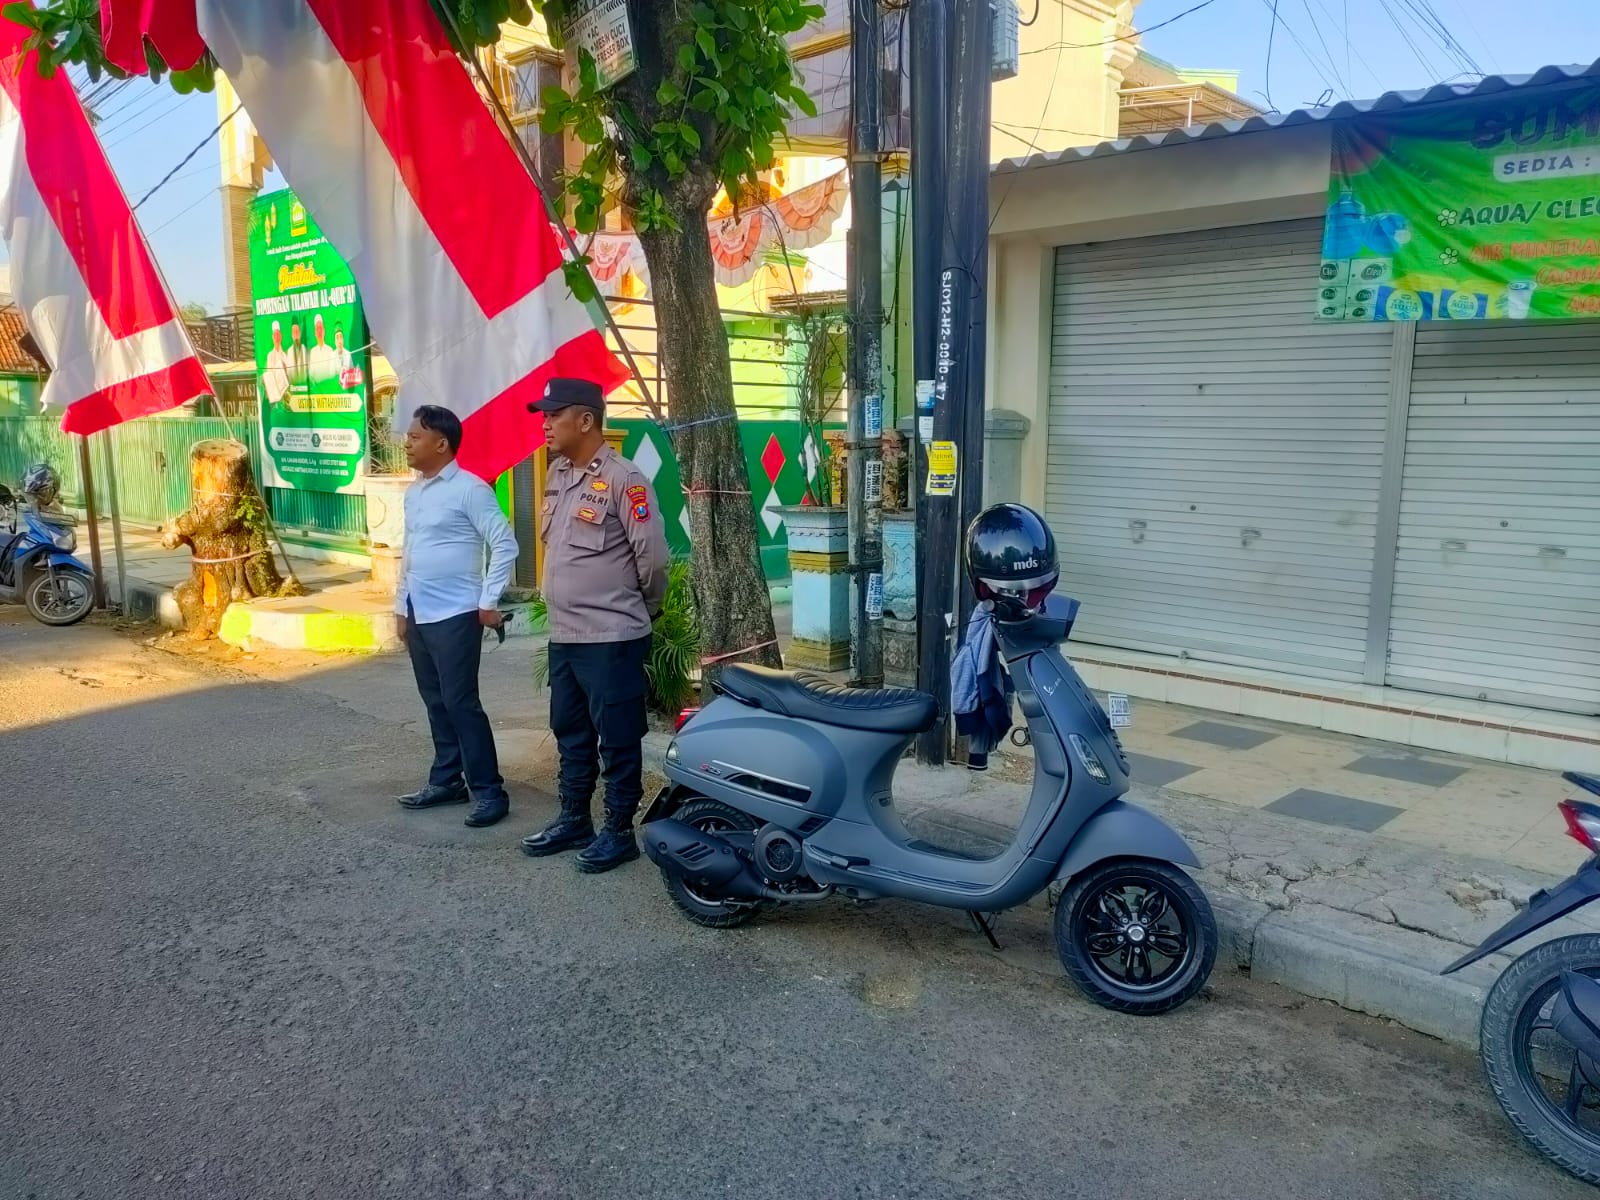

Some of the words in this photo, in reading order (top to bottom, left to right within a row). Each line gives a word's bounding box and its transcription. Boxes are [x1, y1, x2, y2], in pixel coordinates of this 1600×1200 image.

[1503, 155, 1574, 175] SEDIA
[1459, 201, 1542, 226] AQUA/
[580, 492, 608, 506] POLRI
[1013, 557, 1039, 571] mds
